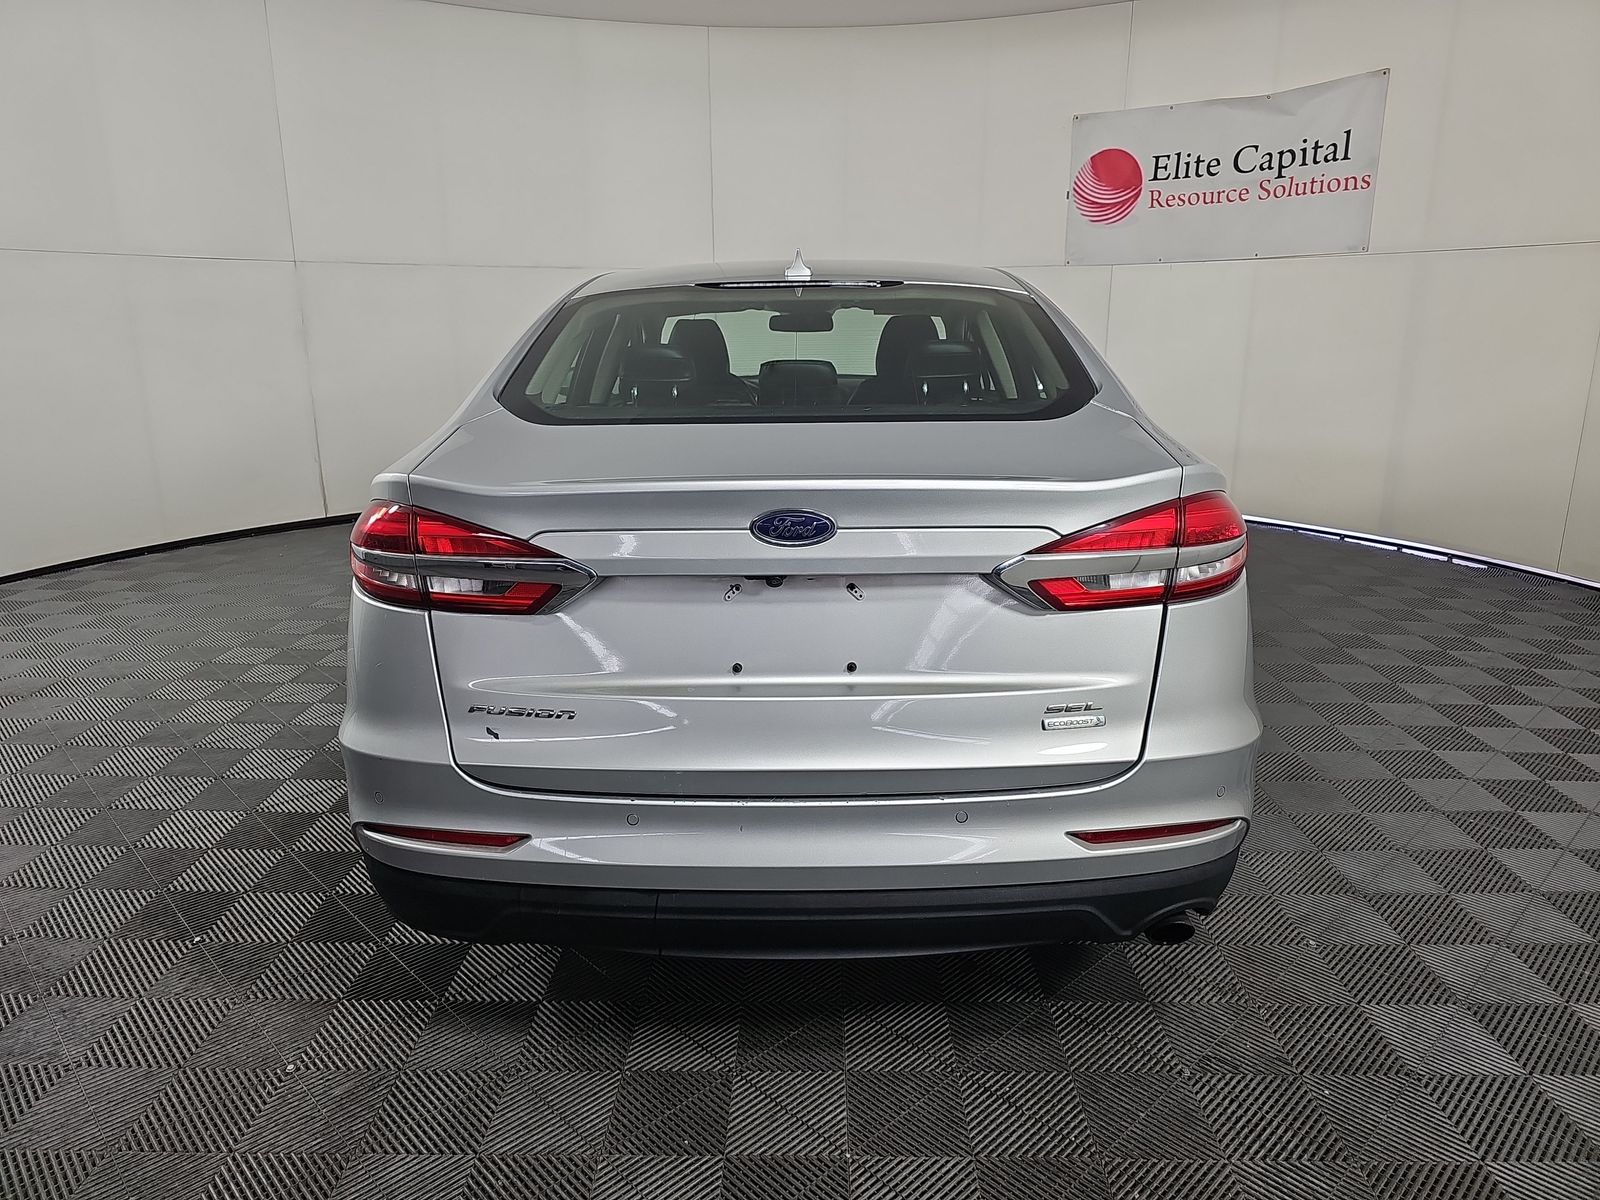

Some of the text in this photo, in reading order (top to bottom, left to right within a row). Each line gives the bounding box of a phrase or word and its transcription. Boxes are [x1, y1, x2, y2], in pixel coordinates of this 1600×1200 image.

[1148, 129, 1352, 181] Elite Capital
[1148, 173, 1372, 209] Resource Solutions
[768, 516, 818, 537] Ford
[468, 704, 577, 720] FUSION
[1043, 701, 1104, 714] SEL
